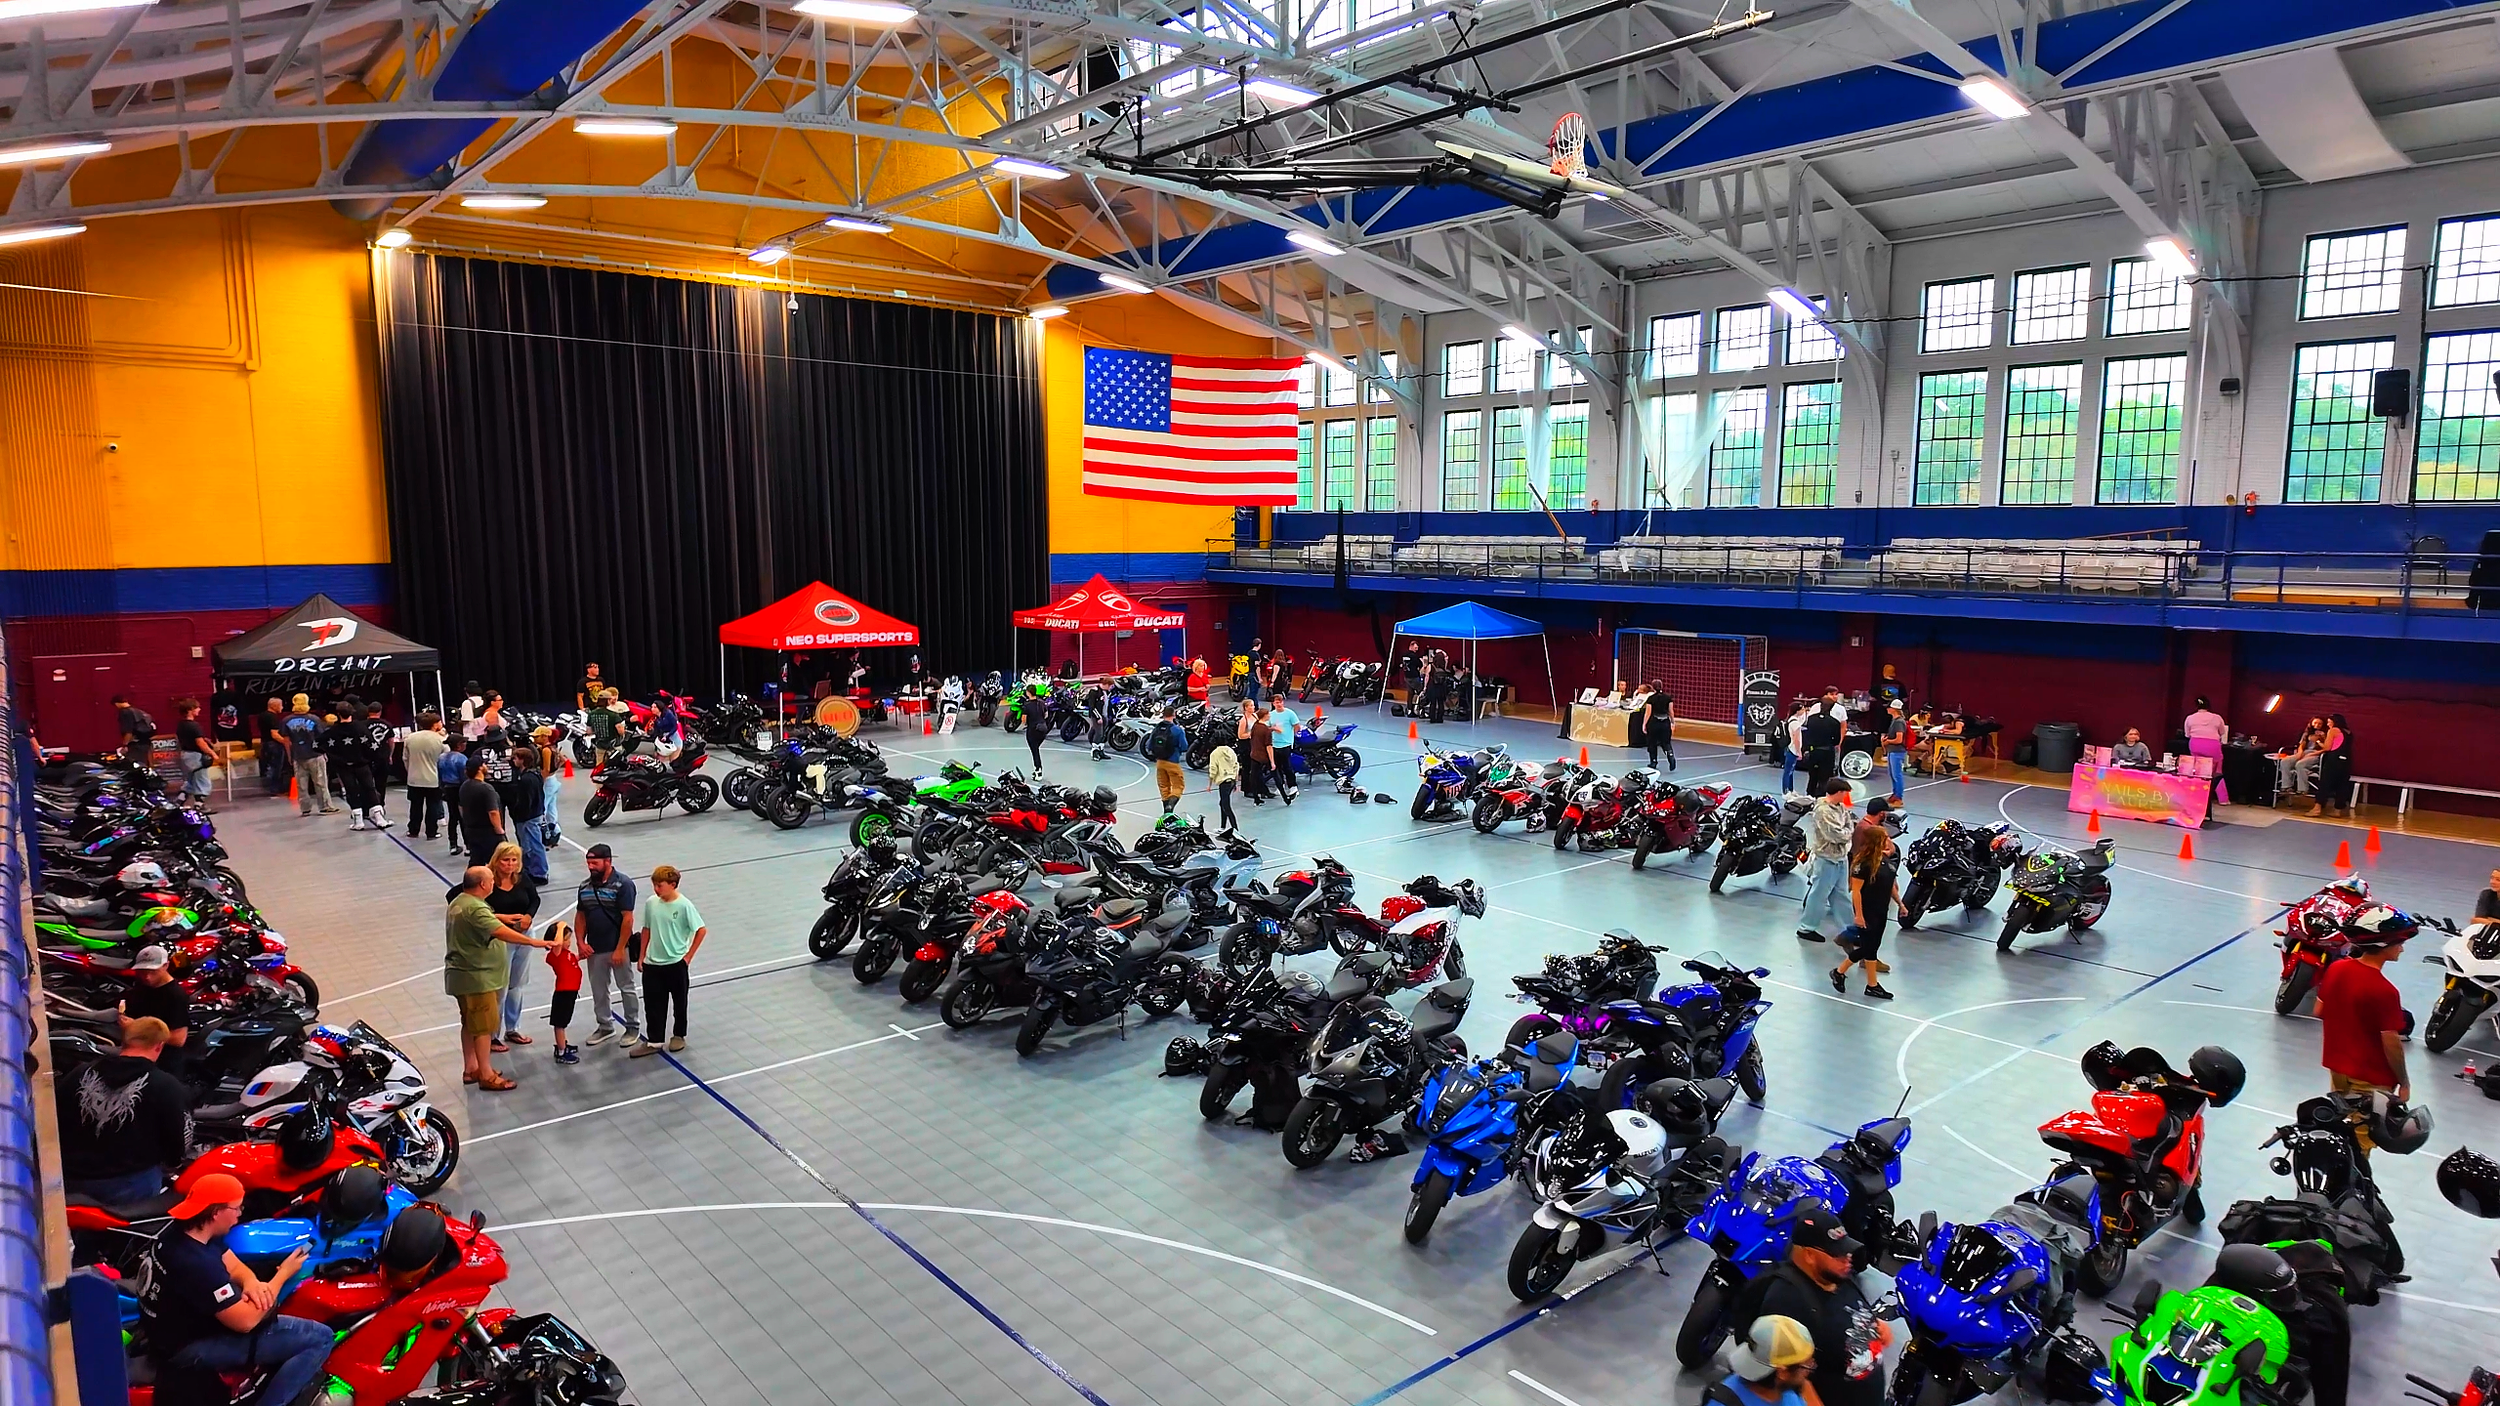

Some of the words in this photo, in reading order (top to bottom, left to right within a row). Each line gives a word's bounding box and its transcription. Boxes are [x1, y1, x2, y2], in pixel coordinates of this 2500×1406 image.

[1045, 617, 1080, 630] DUCATI
[1133, 614, 1184, 628] DUCATI
[785, 634, 814, 646] NEO
[816, 631, 913, 645] SUPERSPORTS
[274, 655, 392, 674] DREAMT
[245, 673, 299, 695] RIDE
[300, 674, 324, 691] IN
[2102, 781, 2146, 798] NAILS
[2152, 790, 2174, 803] BY
[422, 1297, 458, 1315] Ninja
